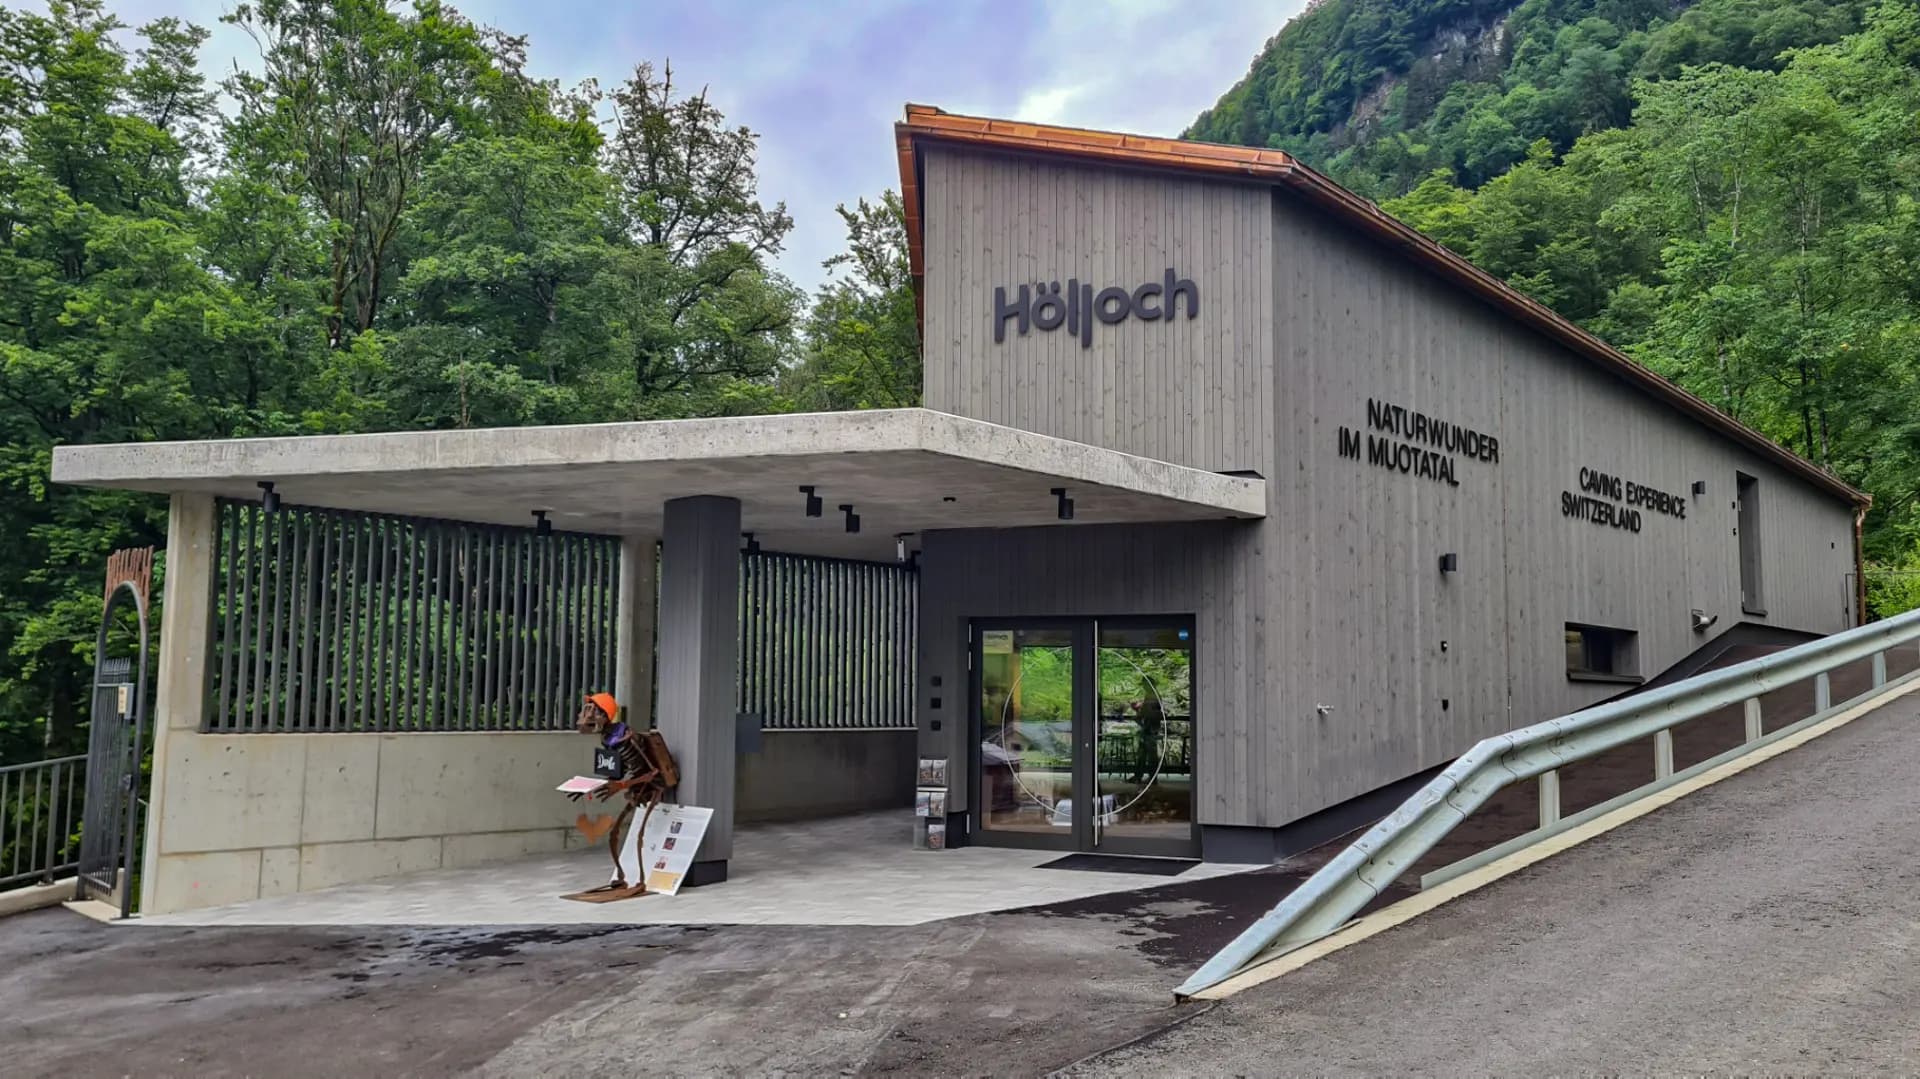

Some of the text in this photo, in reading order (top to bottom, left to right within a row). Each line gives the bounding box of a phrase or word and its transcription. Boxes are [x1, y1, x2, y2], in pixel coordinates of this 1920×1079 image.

[994, 267, 1199, 349] Hölloch
[1338, 425, 1460, 487] IM MUOTATAL
[1368, 397, 1499, 464] NATURWUNDER
[1561, 490, 1642, 533] SWITZERLAND
[1580, 466, 1687, 519] CAVING EXPERIENCE
